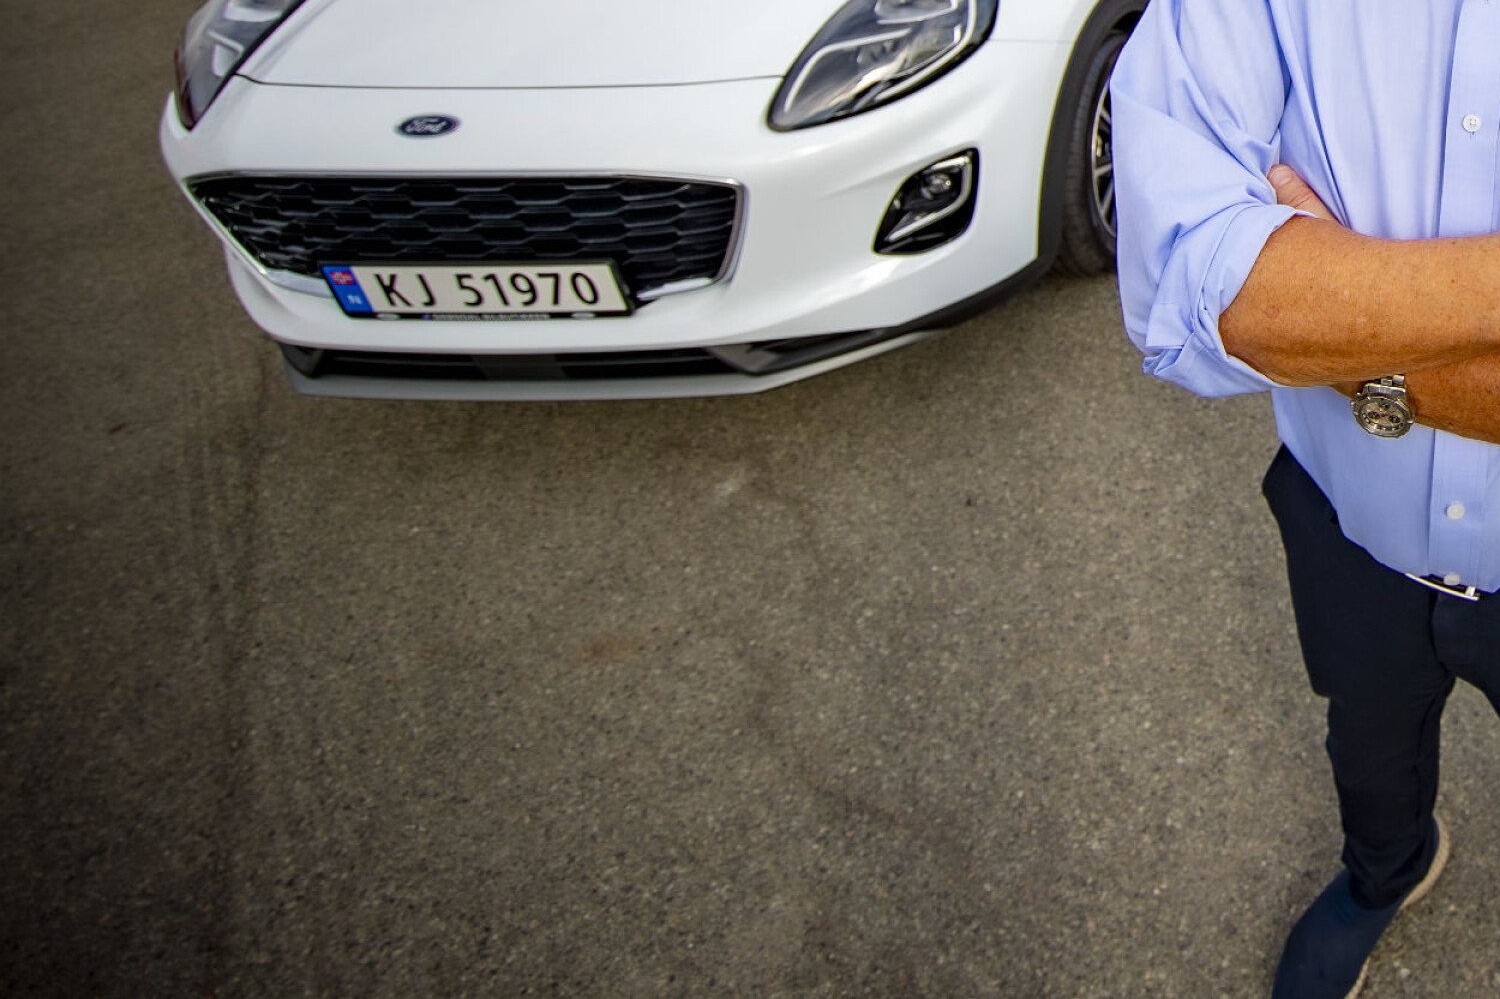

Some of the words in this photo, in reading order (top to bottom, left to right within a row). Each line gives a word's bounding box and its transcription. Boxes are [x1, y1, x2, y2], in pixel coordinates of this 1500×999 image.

[406, 117, 447, 133] Ford
[373, 272, 438, 308] KJ
[454, 271, 600, 308] 51970
